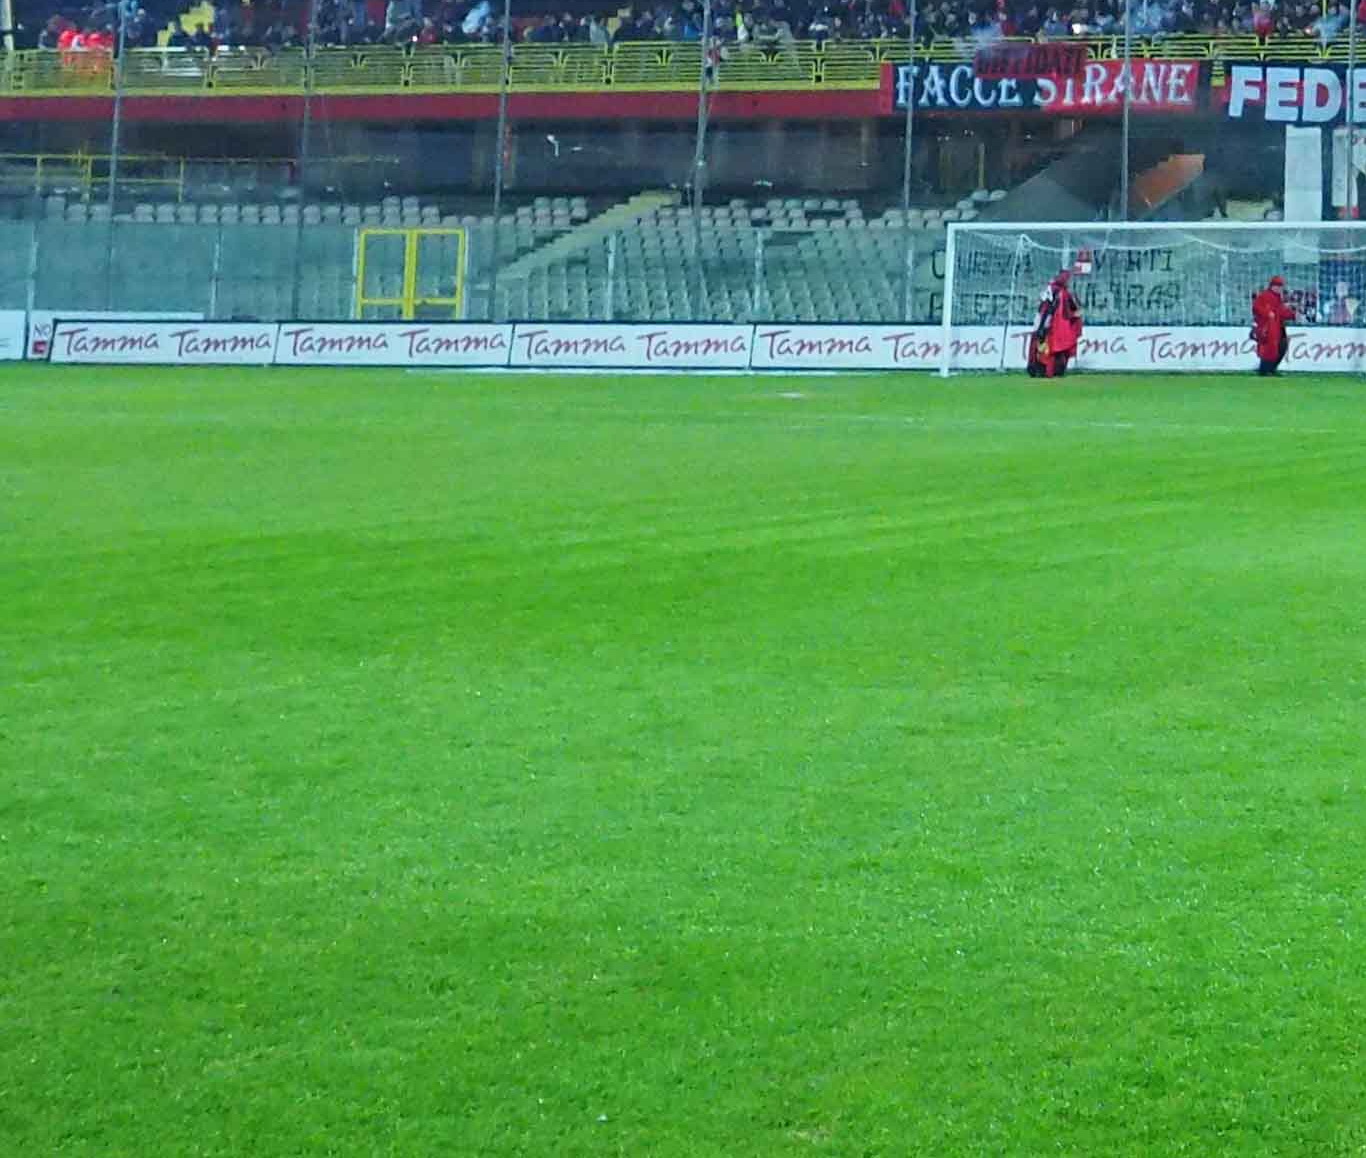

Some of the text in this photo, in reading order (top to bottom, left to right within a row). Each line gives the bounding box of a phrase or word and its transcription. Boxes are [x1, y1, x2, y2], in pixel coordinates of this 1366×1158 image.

[57, 326, 272, 358] Tamma Tamma
[281, 327, 507, 358] Tamma Tamma
[517, 329, 746, 360] Tamma Tamma
[759, 329, 873, 359] Tamma
[1011, 331, 1127, 362] Tma
